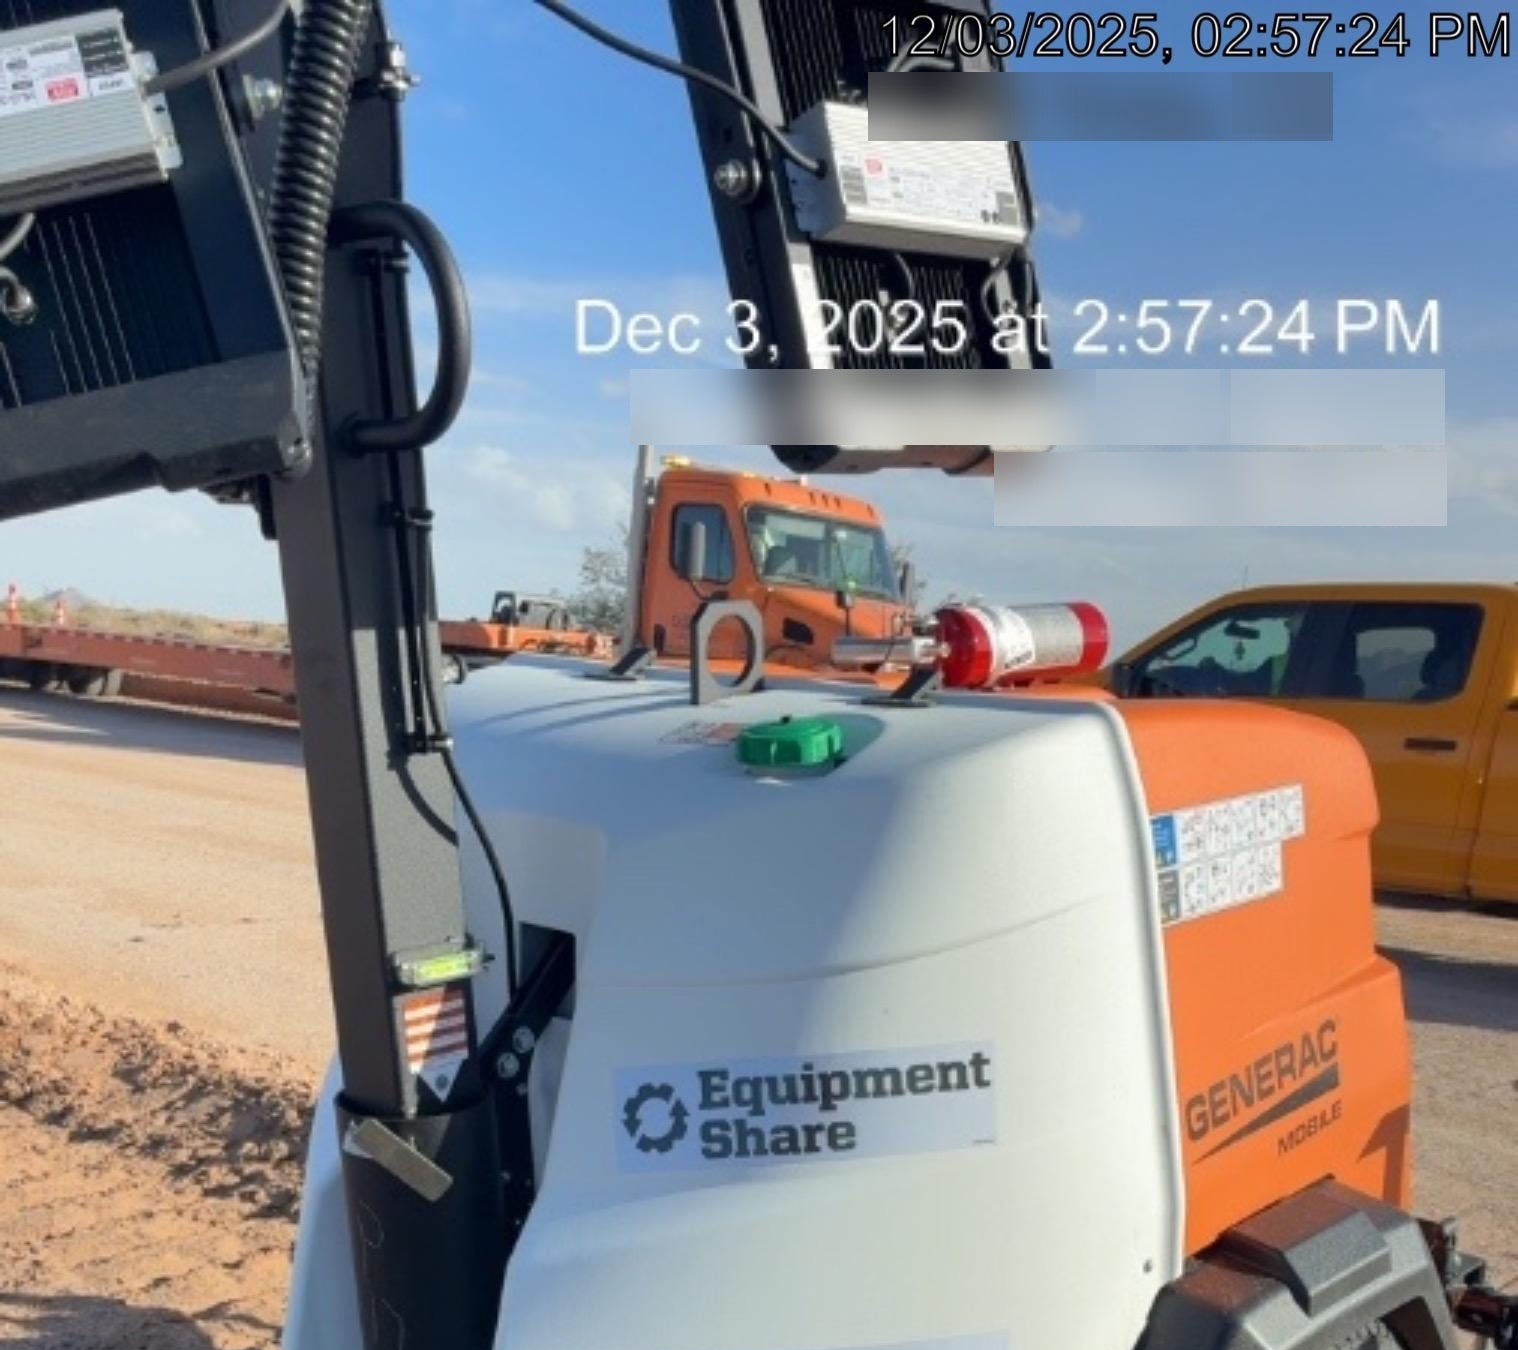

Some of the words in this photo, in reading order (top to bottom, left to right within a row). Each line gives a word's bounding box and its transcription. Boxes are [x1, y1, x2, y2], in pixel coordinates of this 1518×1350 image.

[697, 1051, 991, 1116] Equipment
[1186, 1019, 1338, 1142] GENERAC
[700, 1118, 857, 1160] Share
[1277, 1099, 1343, 1156] MOBILE
